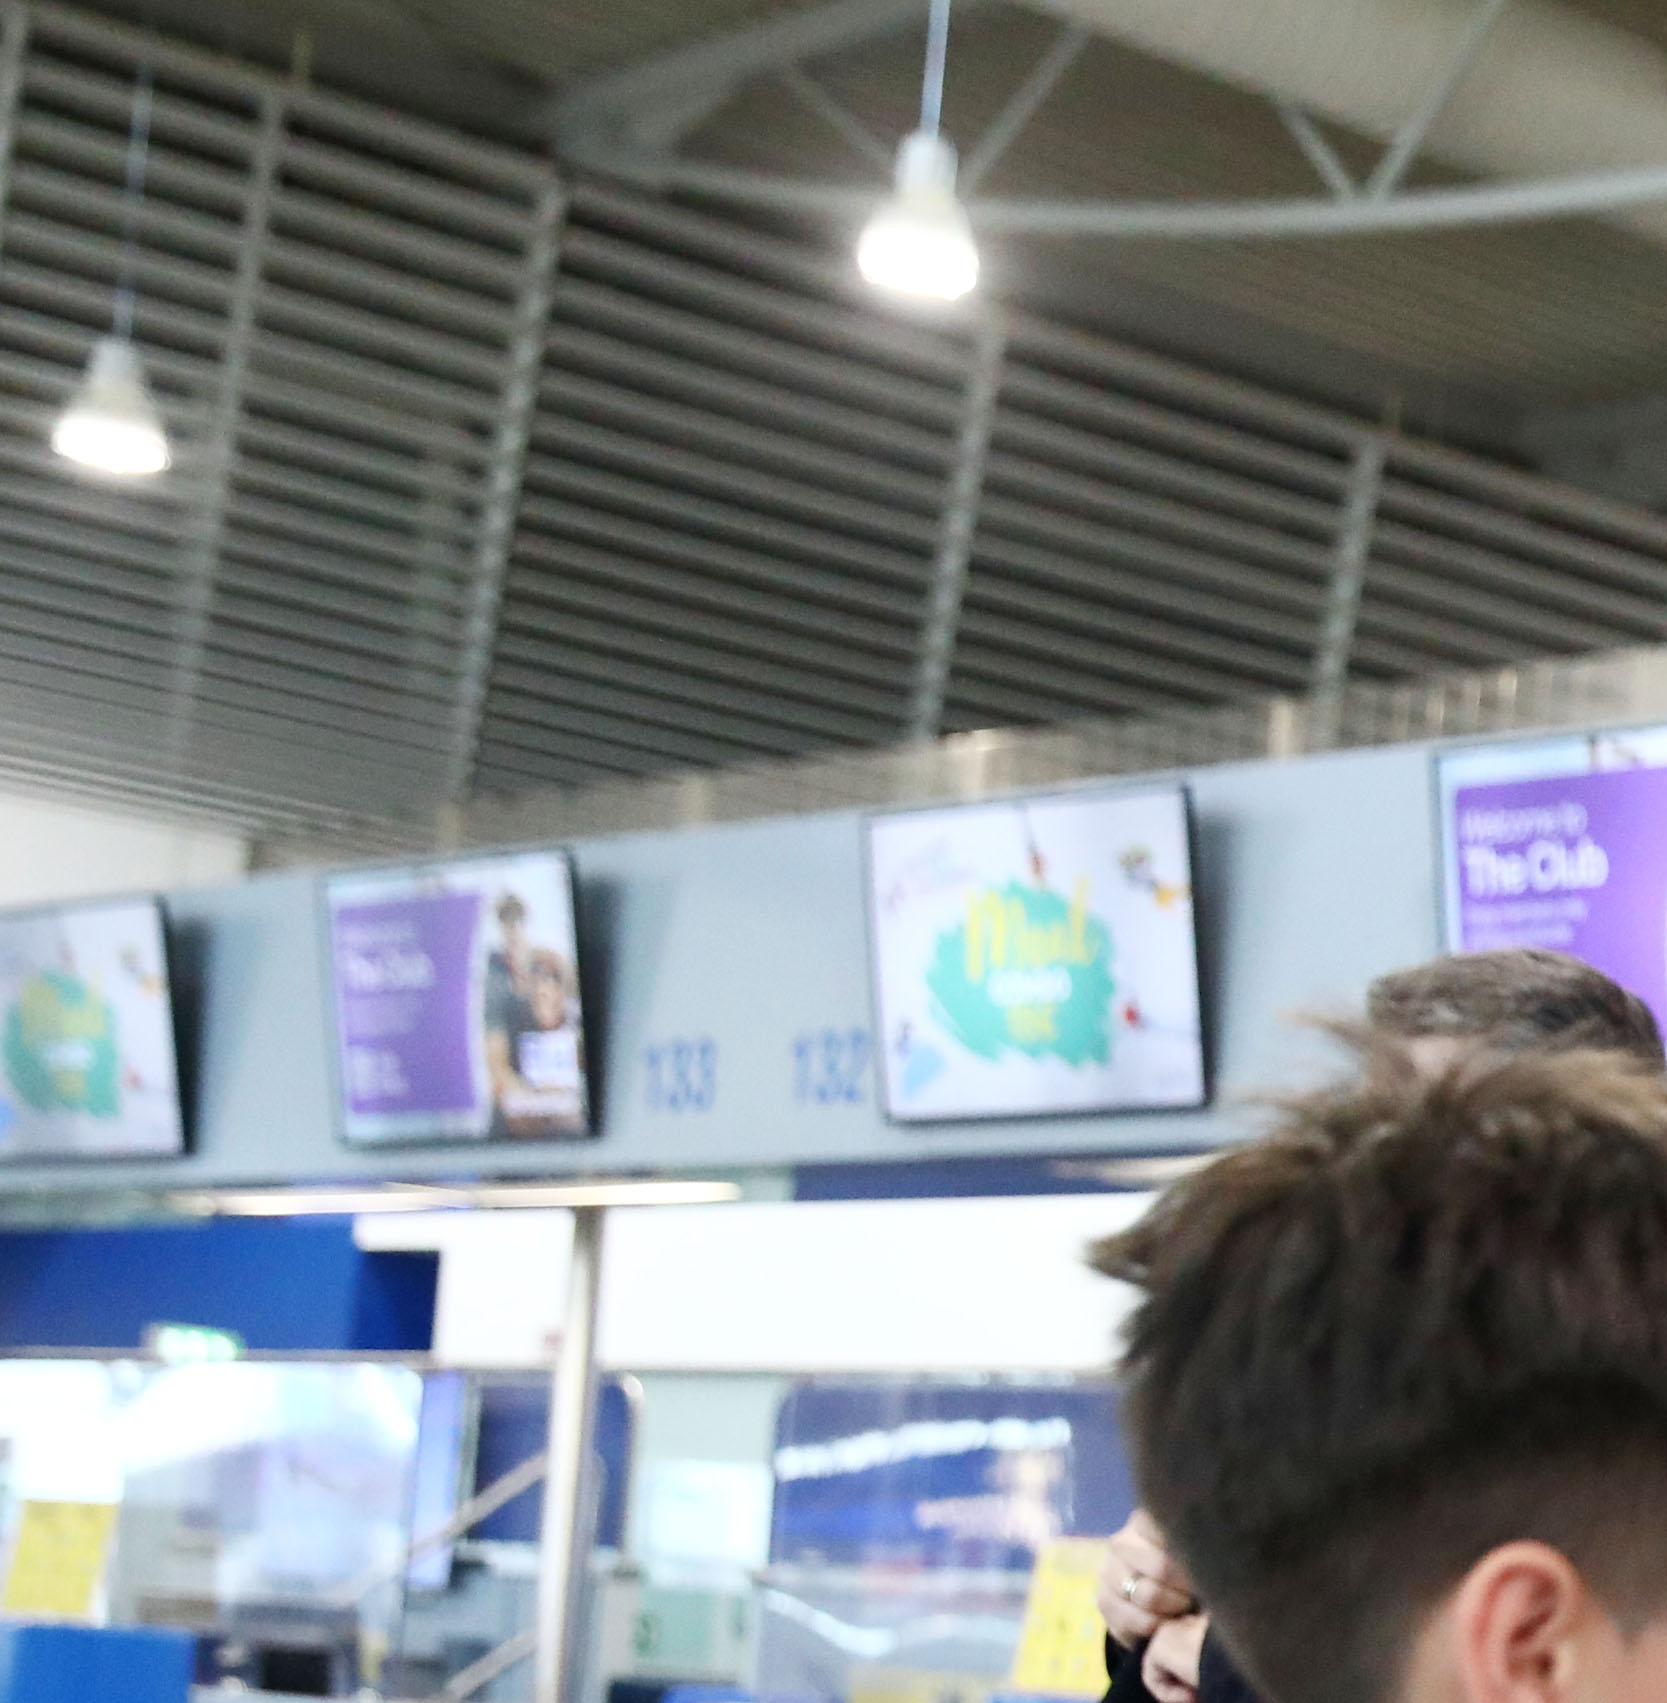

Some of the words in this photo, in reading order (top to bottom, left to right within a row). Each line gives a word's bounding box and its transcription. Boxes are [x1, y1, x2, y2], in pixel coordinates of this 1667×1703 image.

[1464, 845, 1526, 896] The
[1526, 833, 1609, 892] Club
[646, 1036, 718, 1113] 133
[792, 1028, 874, 1104] 132
